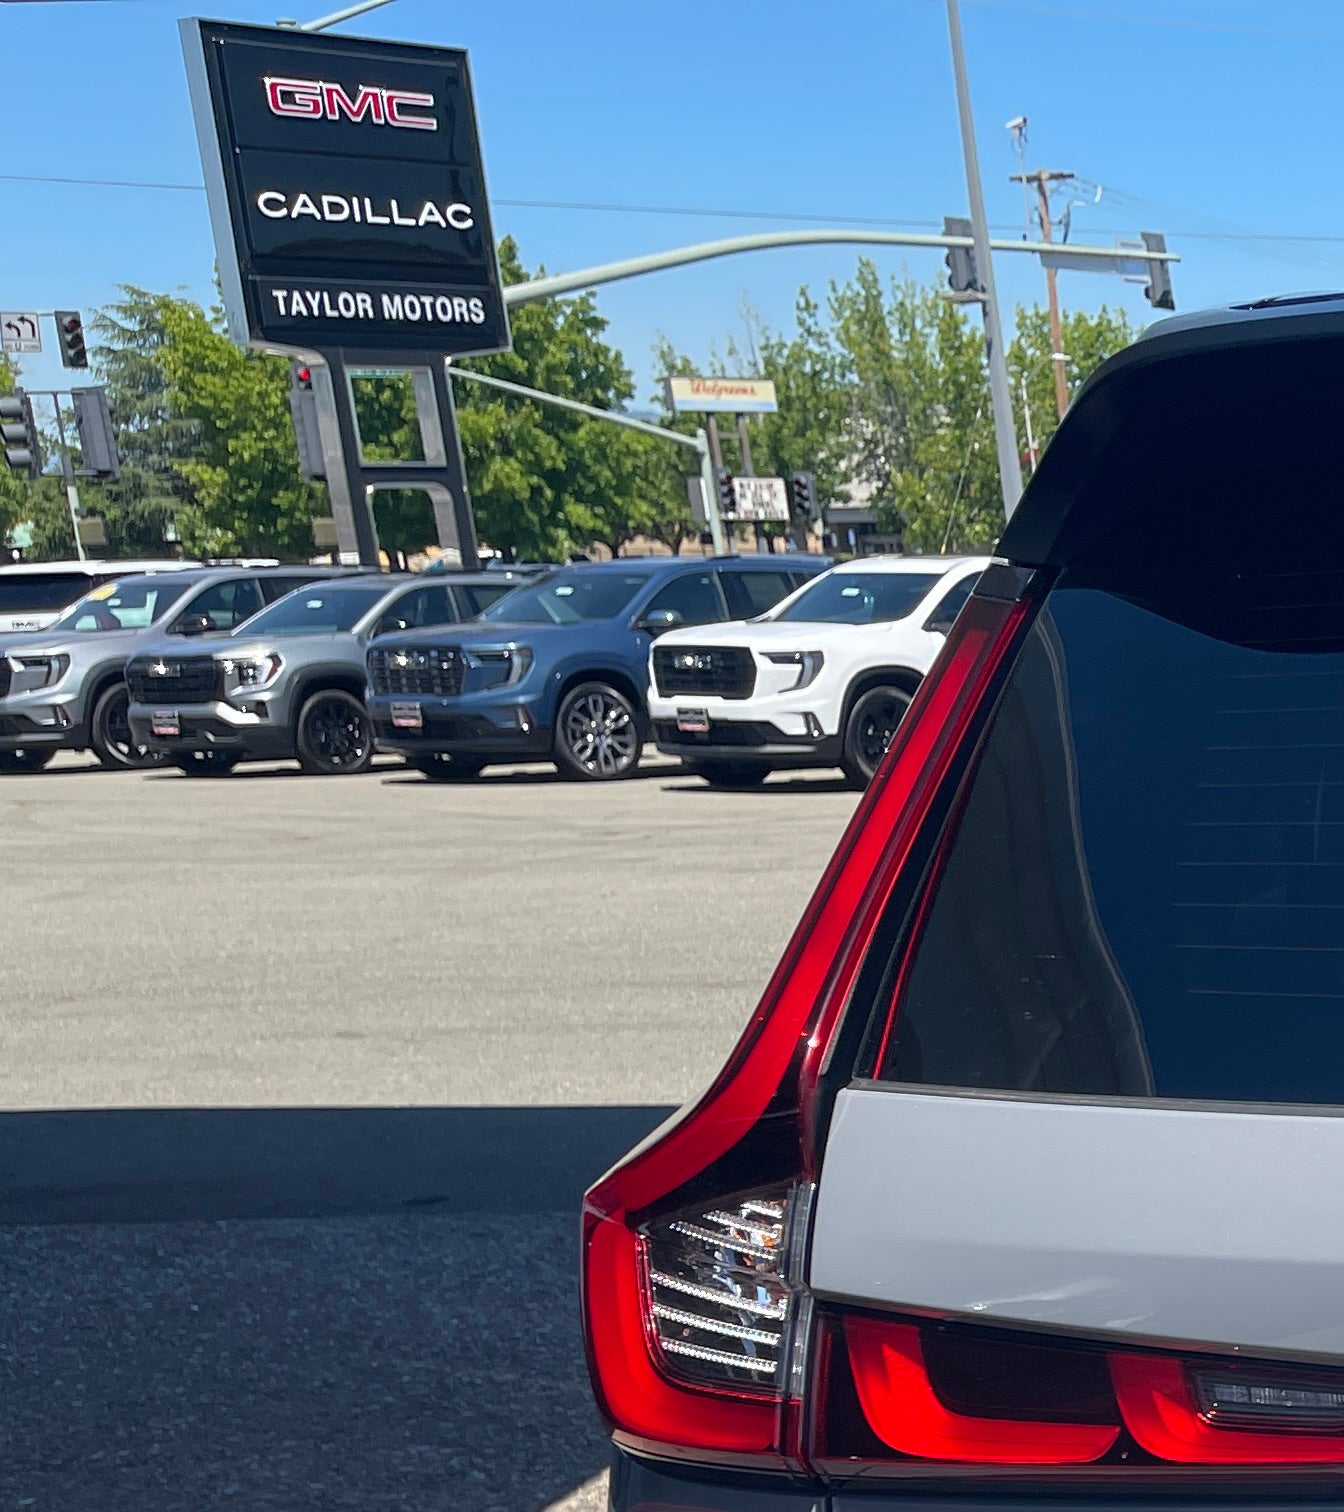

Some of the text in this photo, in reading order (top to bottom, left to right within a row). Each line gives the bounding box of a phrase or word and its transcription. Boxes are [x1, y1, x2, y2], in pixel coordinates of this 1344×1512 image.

[263, 77, 437, 131] GMC
[256, 191, 474, 230] CADILLAC
[271, 289, 486, 324] TAYLOR MOTORS
